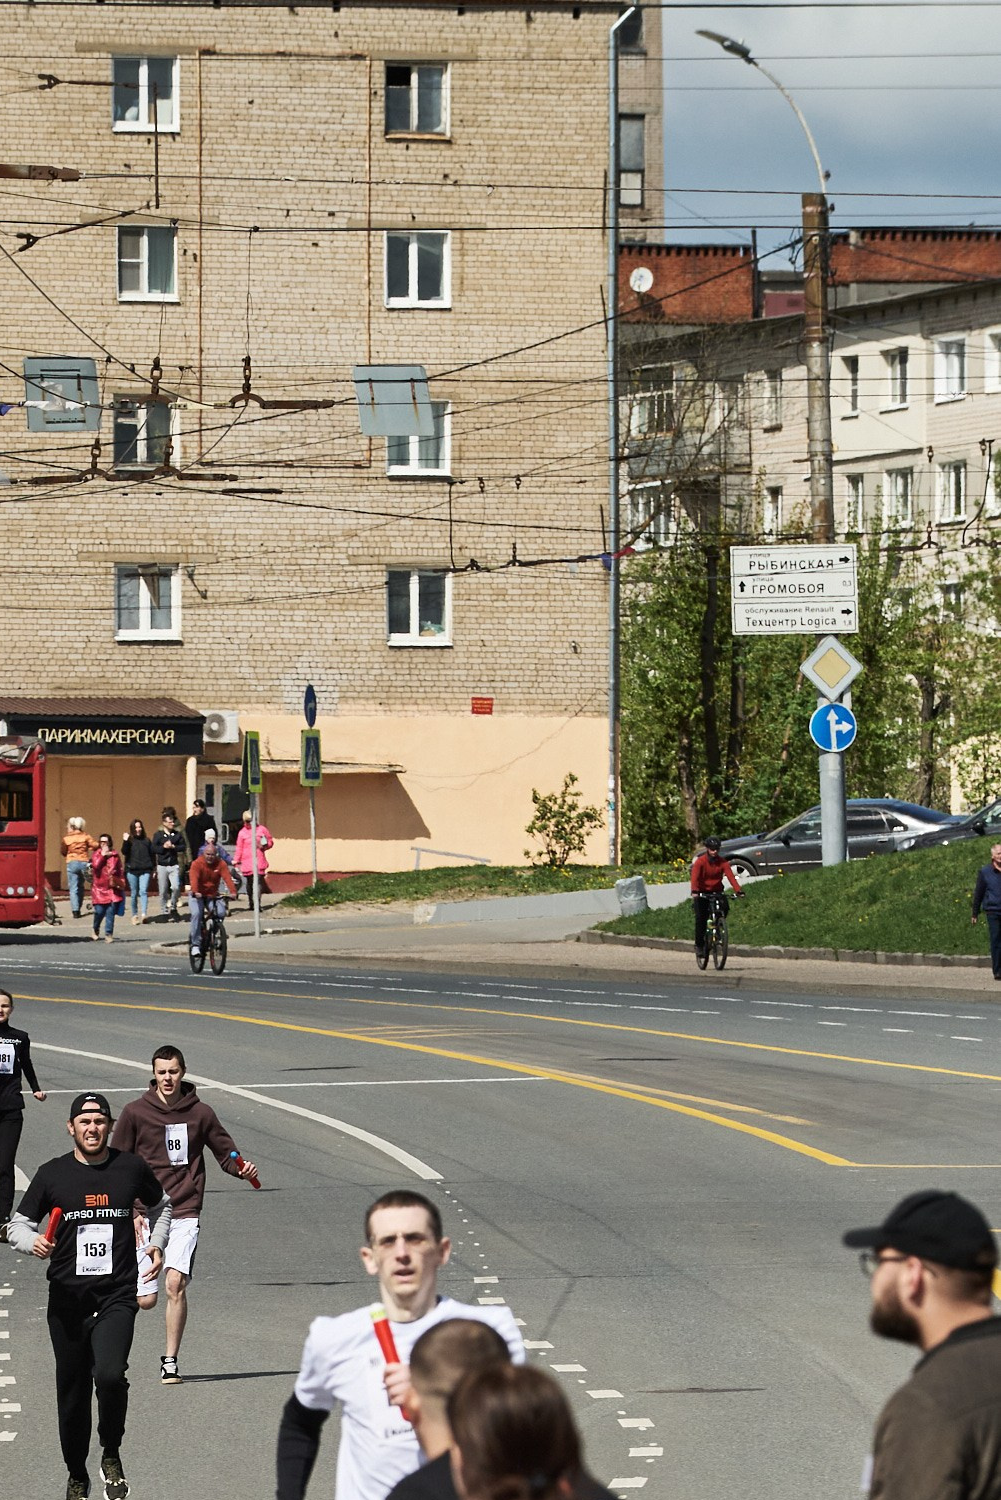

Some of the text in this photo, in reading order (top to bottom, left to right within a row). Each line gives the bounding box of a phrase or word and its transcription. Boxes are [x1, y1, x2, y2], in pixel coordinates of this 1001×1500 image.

[749, 559, 834, 571] РЫБИНСКАЯ
[752, 583, 825, 594] ГРОМОБОЯ
[745, 606, 802, 615] обслуживание
[746, 617, 837, 628] Техцентр Logica
[37, 728, 175, 744] ПАРИКМАХЕРСКАЯ
[168, 1139, 181, 1151] 88
[63, 1208, 130, 1222] VERSO FITNESS
[83, 1243, 107, 1257] 153
